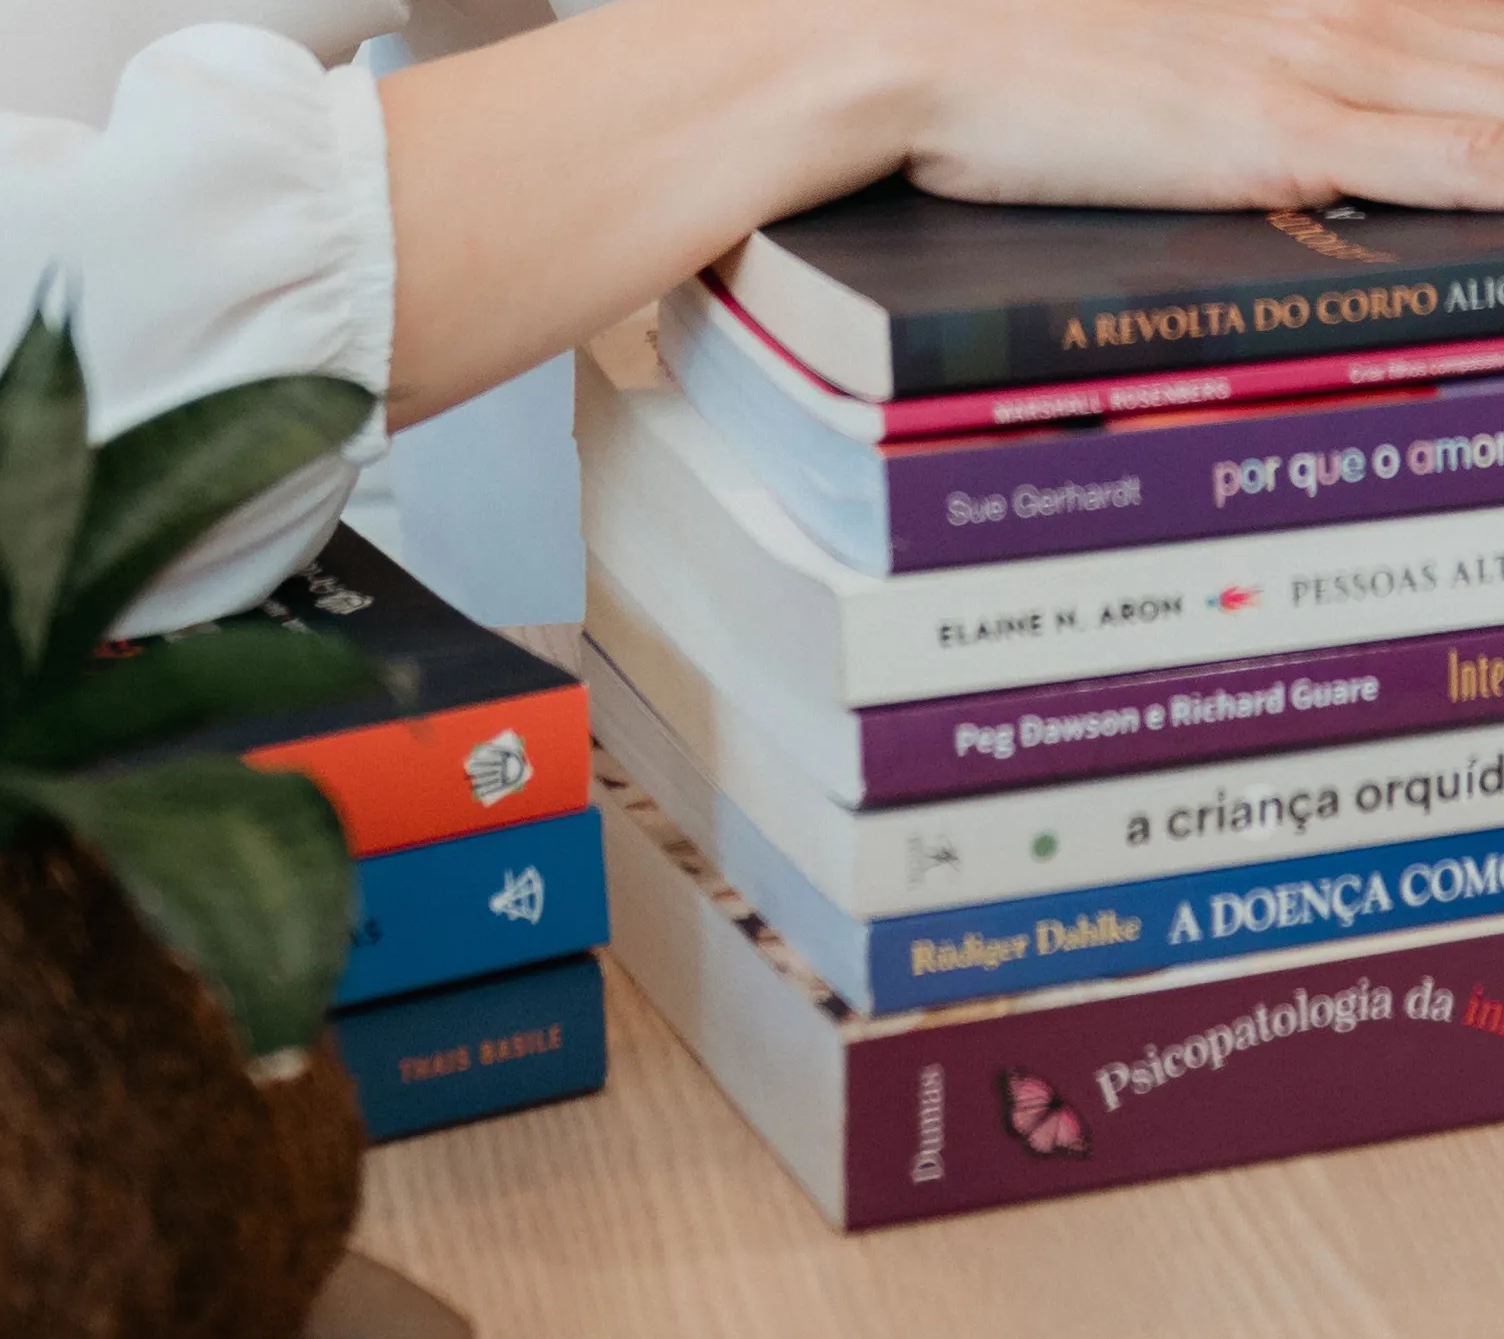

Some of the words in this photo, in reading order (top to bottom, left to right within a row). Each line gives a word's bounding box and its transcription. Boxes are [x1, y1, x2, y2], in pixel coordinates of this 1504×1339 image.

[1062, 321, 1087, 350] A
[1096, 300, 1247, 347] REVOLTA
[1254, 295, 1310, 331] DO
[1317, 283, 1439, 326] CORPO
[1110, 378, 1231, 411] ROSENBERG
[946, 491, 1007, 526] Sue
[1012, 475, 1141, 520] Gerhardt
[1214, 456, 1281, 509] por
[1288, 448, 1366, 497] que
[1372, 444, 1401, 478] o
[1293, 564, 1437, 608] PESSOAS
[939, 611, 1041, 647] ELAINE
[1099, 596, 1183, 627] ARON
[956, 723, 1014, 760] Peg
[1020, 703, 1140, 747] Dawson
[1145, 703, 1162, 730] e
[1169, 681, 1285, 727] Richard
[1291, 674, 1379, 711] Guare
[1126, 816, 1151, 846] a
[1167, 786, 1340, 841] criança
[1036, 909, 1143, 956] Dahlke
[1169, 902, 1200, 945] A
[1211, 872, 1393, 937] DOENÇA
[1094, 977, 1394, 1113] Psicopatologia
[1404, 975, 1455, 1023] da
[912, 1063, 944, 1184] Dumas
